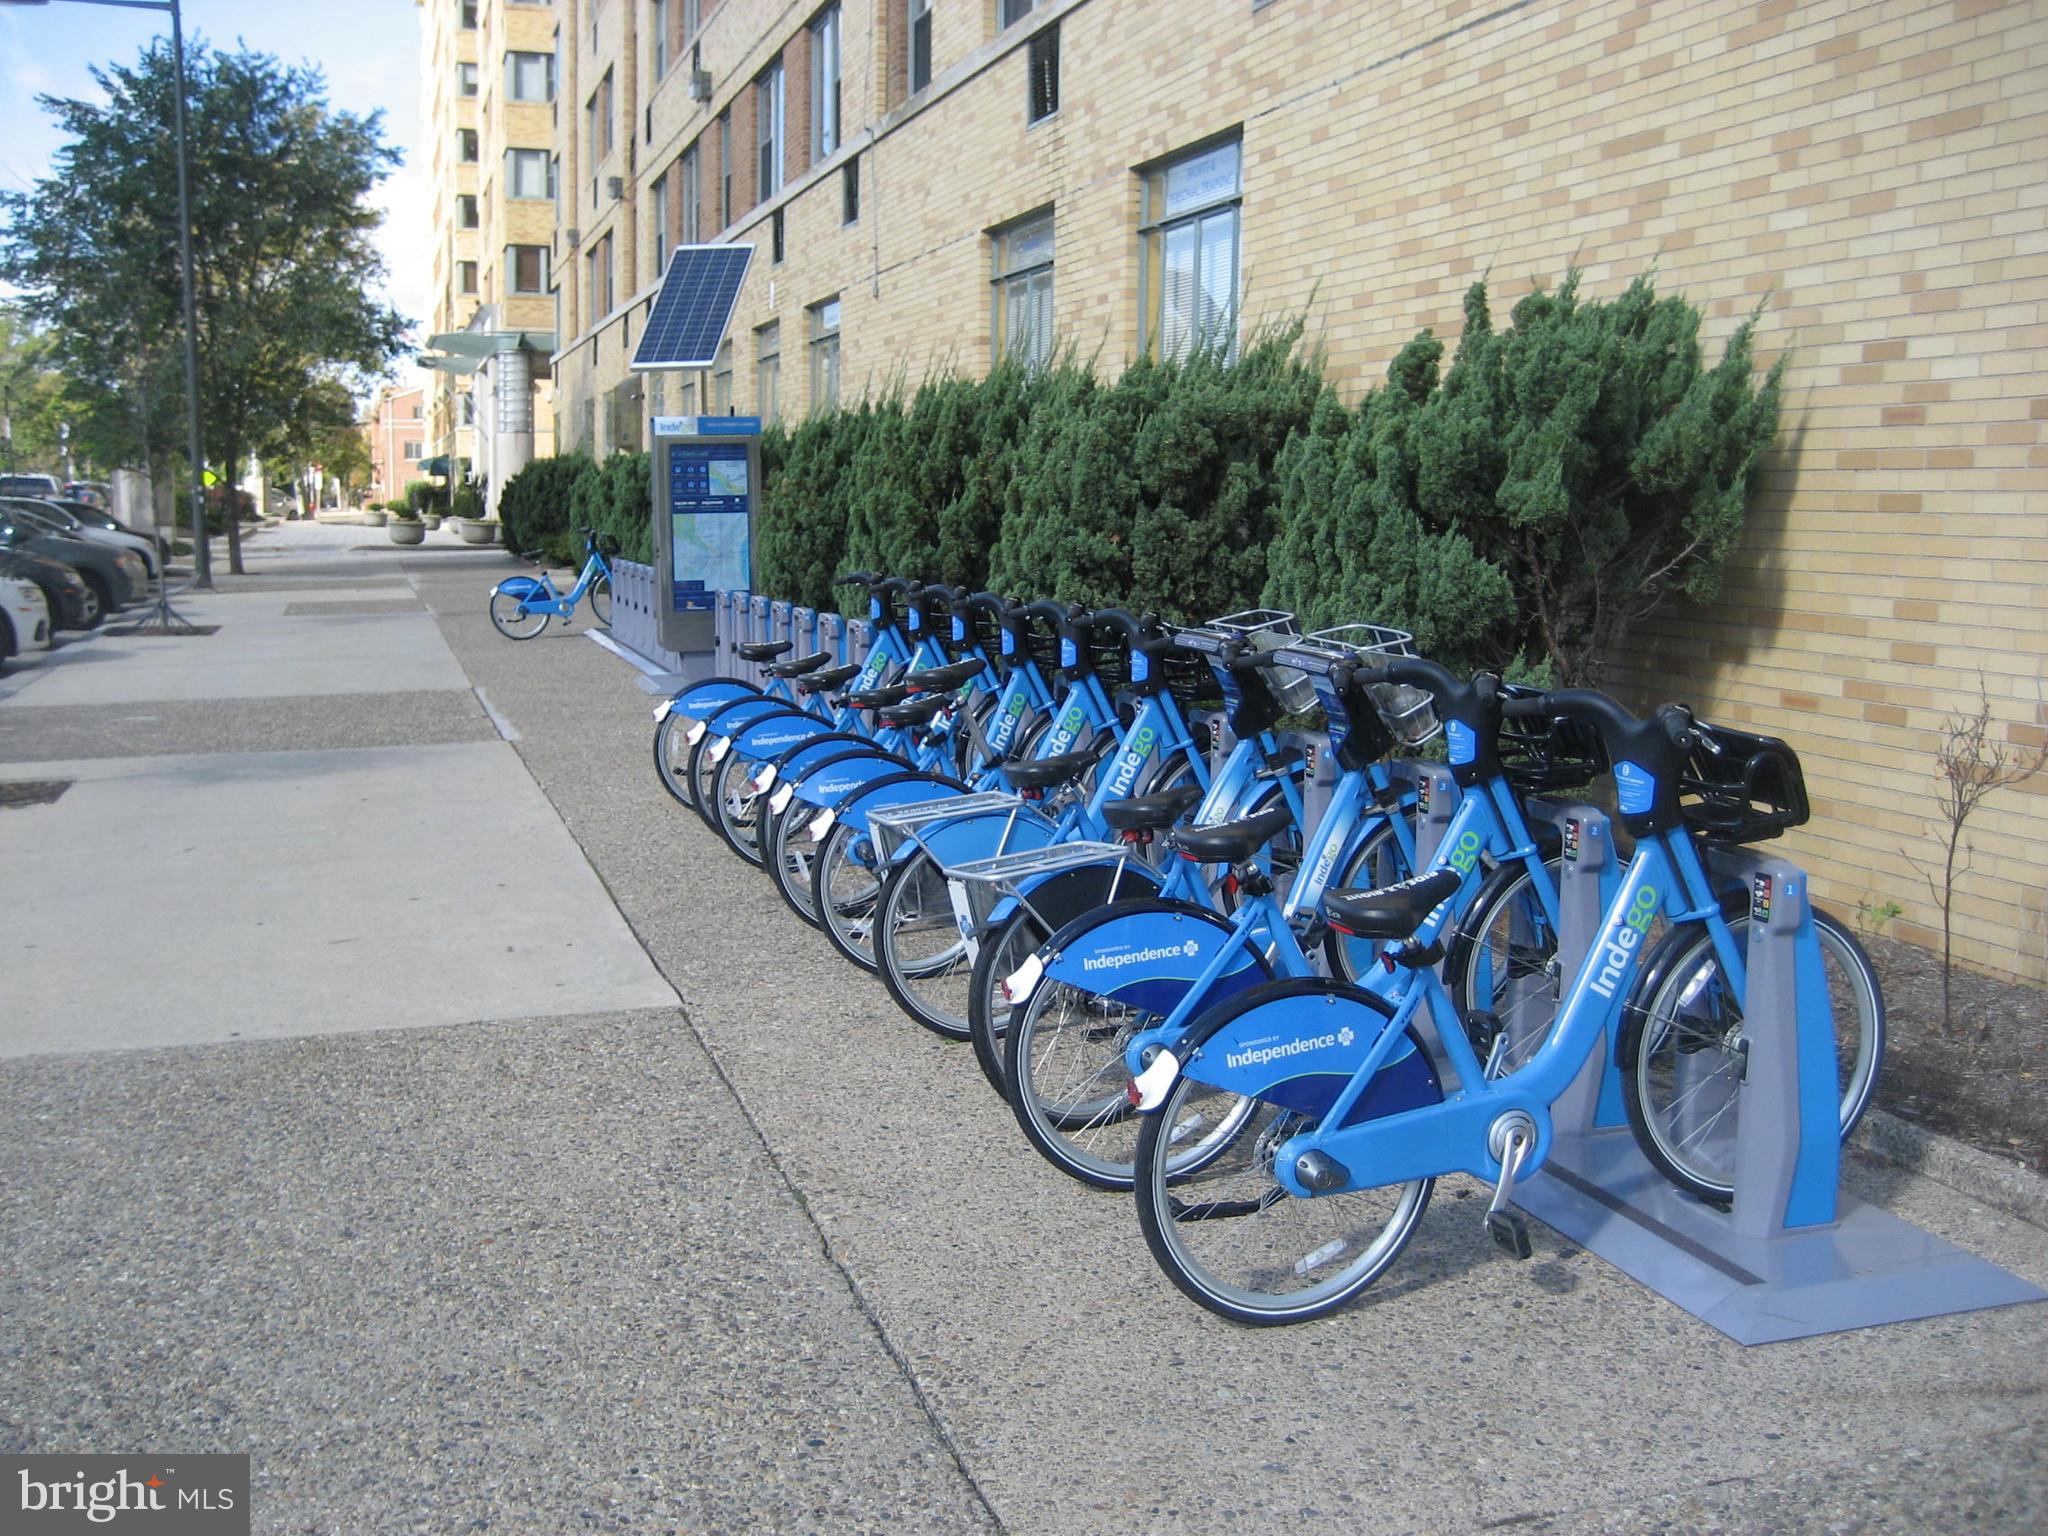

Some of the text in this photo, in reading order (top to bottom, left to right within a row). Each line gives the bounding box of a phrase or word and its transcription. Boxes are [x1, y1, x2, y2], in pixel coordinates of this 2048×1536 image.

[1108, 727, 1153, 797] Indego
[1591, 826, 1598, 836] 2
[1787, 884, 1793, 895] 1
[1590, 885, 1657, 998] Indego
[1083, 944, 1181, 971] Independence
[1226, 1033, 1335, 1068] Independence
